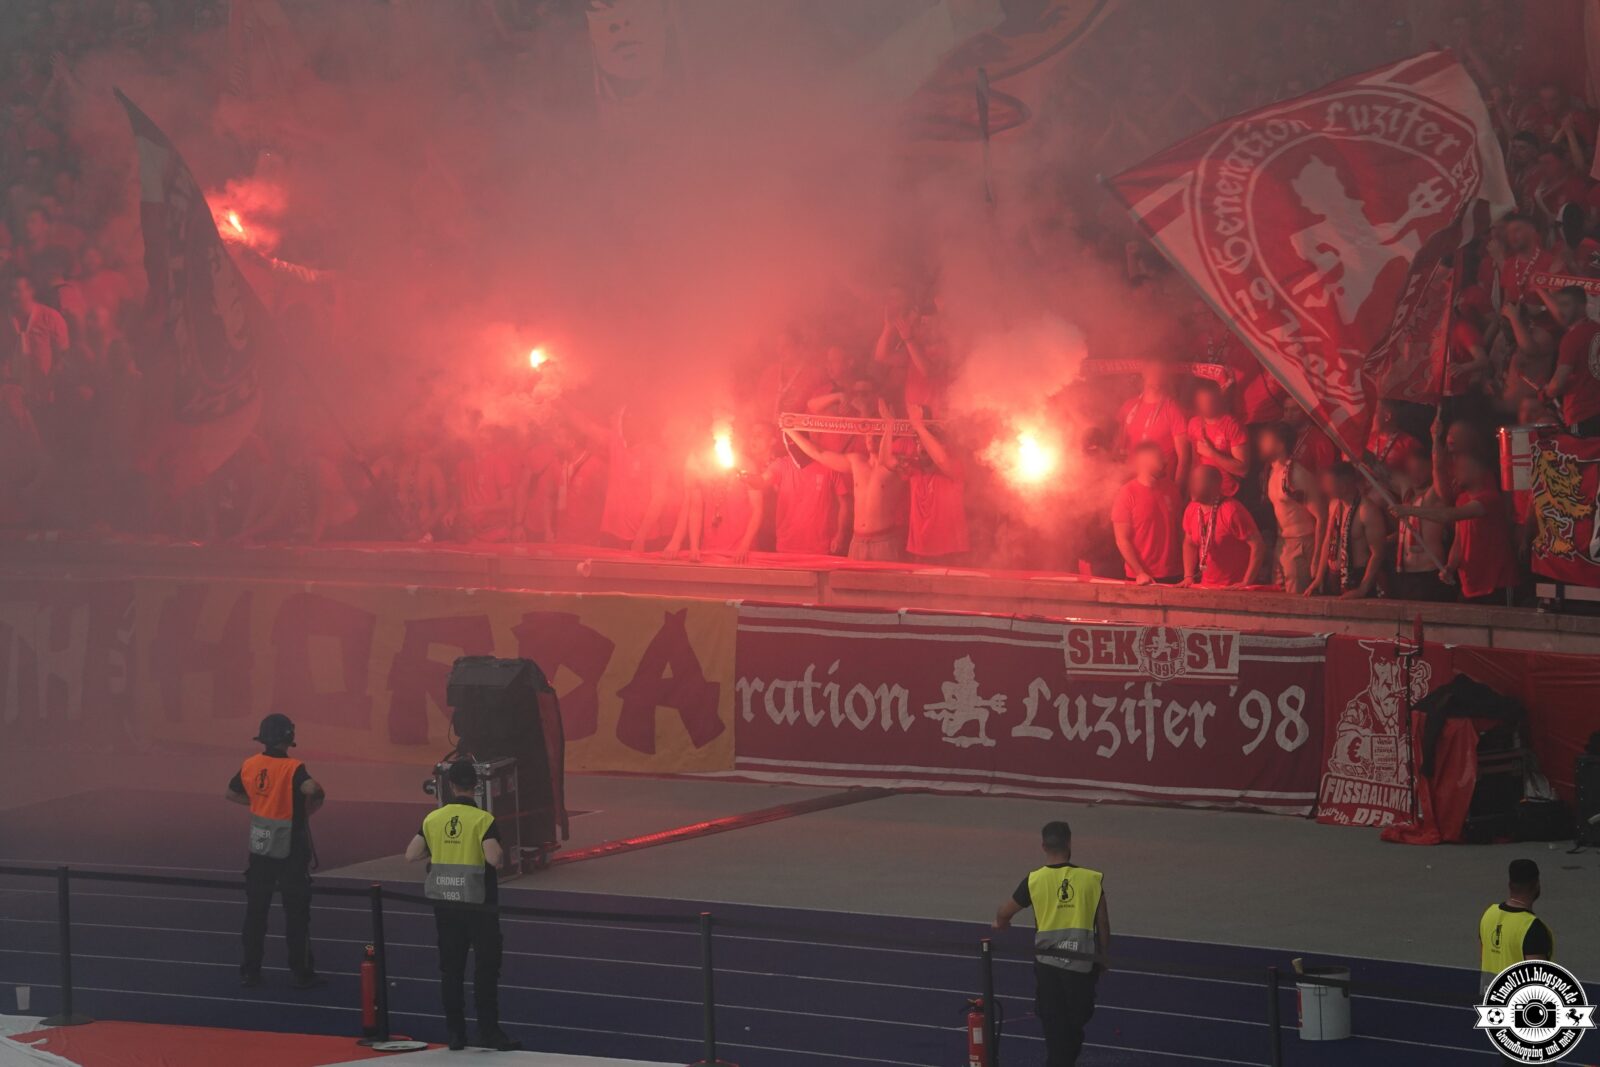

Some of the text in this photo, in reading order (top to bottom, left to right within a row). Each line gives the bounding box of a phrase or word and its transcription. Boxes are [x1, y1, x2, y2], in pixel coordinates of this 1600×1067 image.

[1322, 102, 1461, 155] Luzifer
[1068, 627, 1234, 669] SEK SV
[1011, 677, 1217, 763] Luzifer
[1227, 683, 1310, 756] '98
